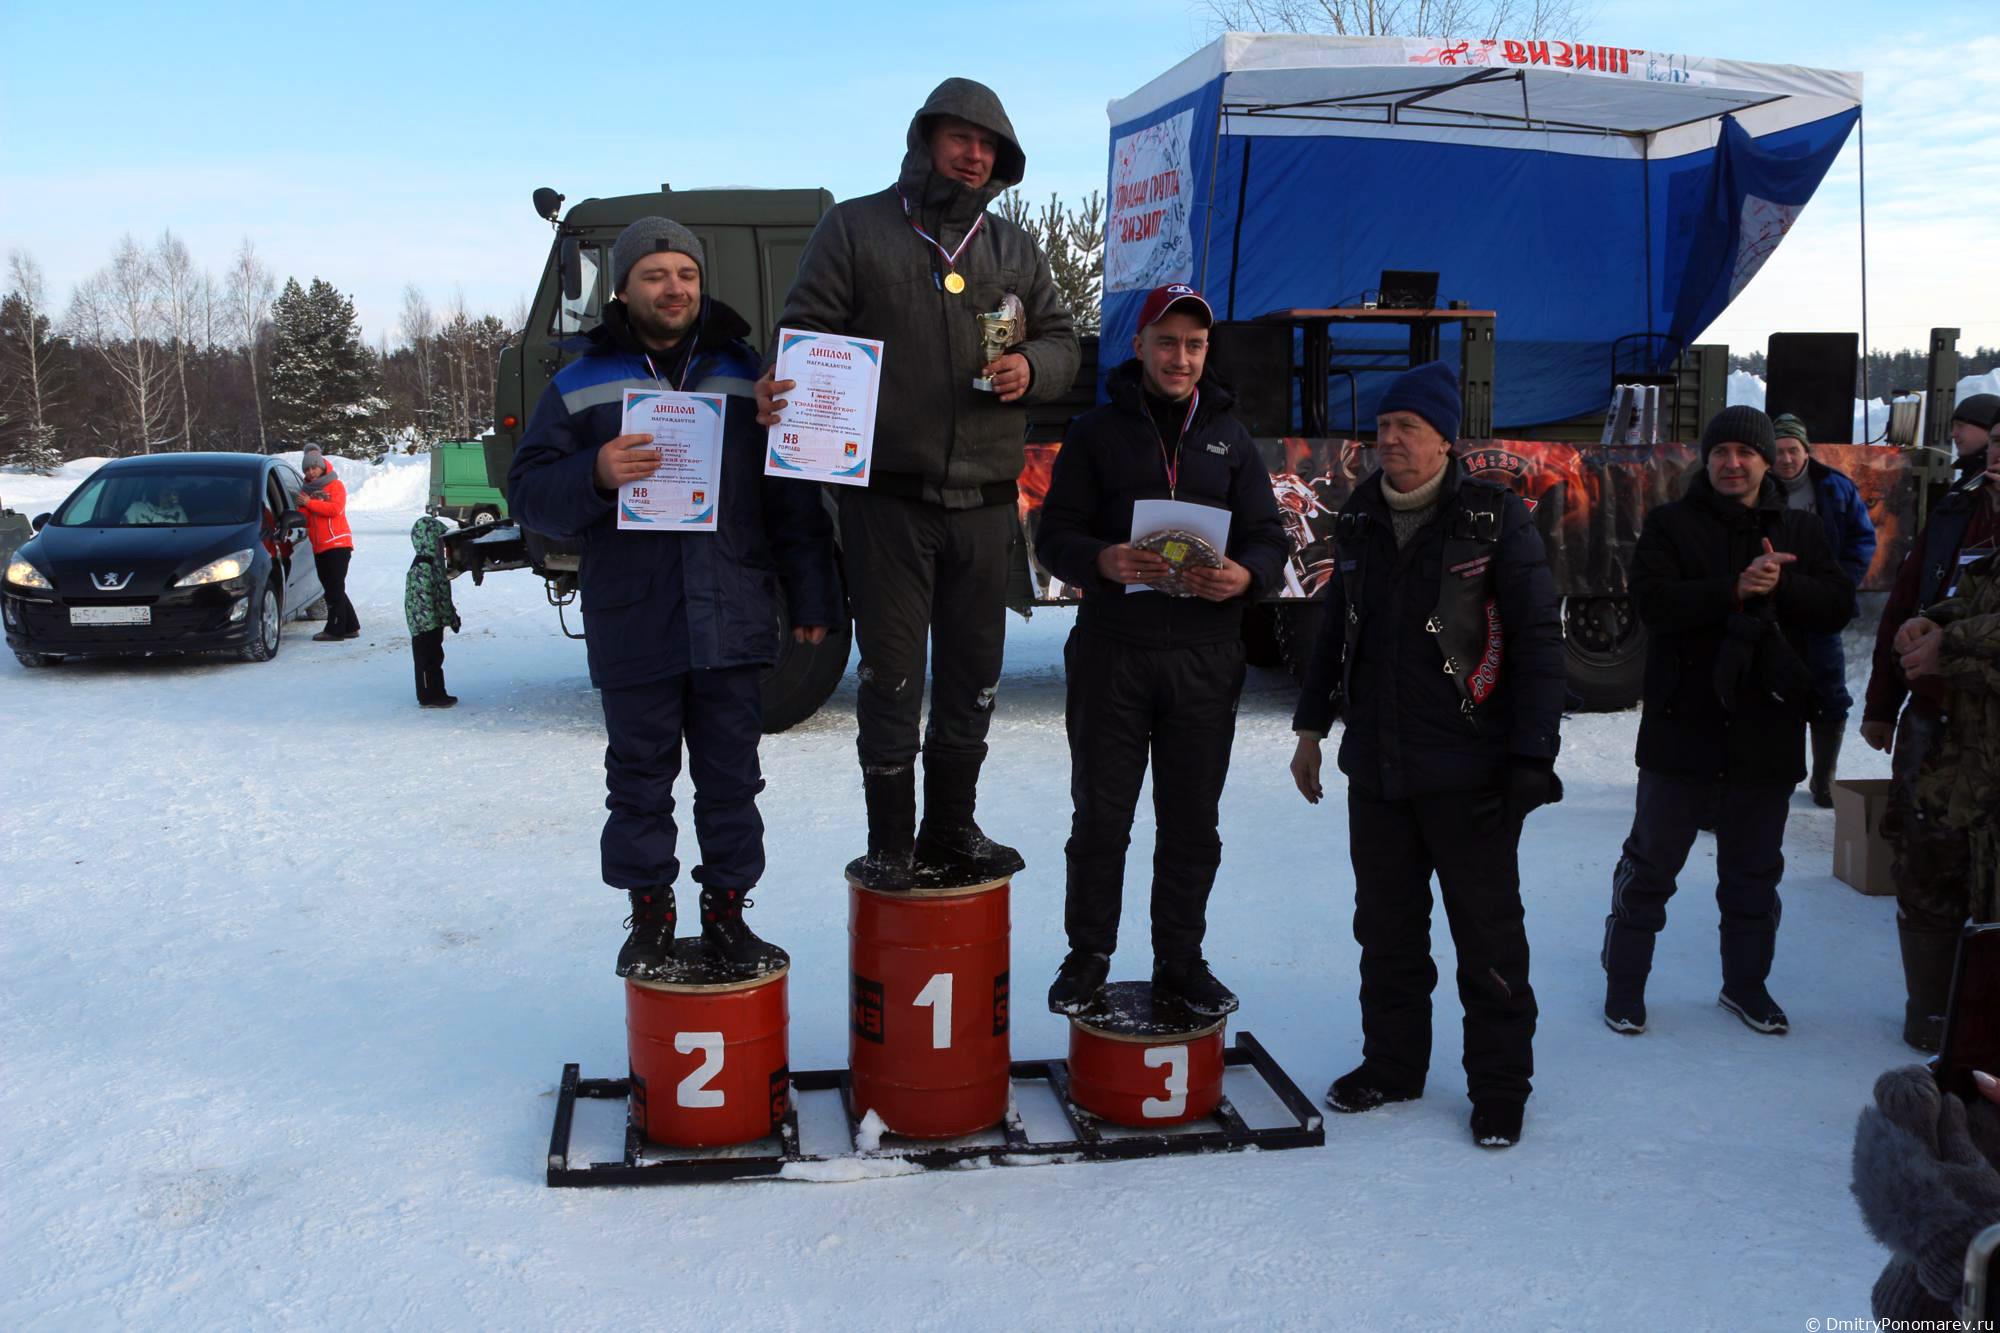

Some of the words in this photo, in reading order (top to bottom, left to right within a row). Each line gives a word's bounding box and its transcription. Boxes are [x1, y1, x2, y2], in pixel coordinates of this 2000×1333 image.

[809, 348, 851, 360] ДИПЛОМ
[653, 404, 695, 414] ДИПЛОМ
[912, 972, 953, 1050] 1
[674, 1031, 725, 1108] 2
[1142, 1045, 1188, 1119] 3
